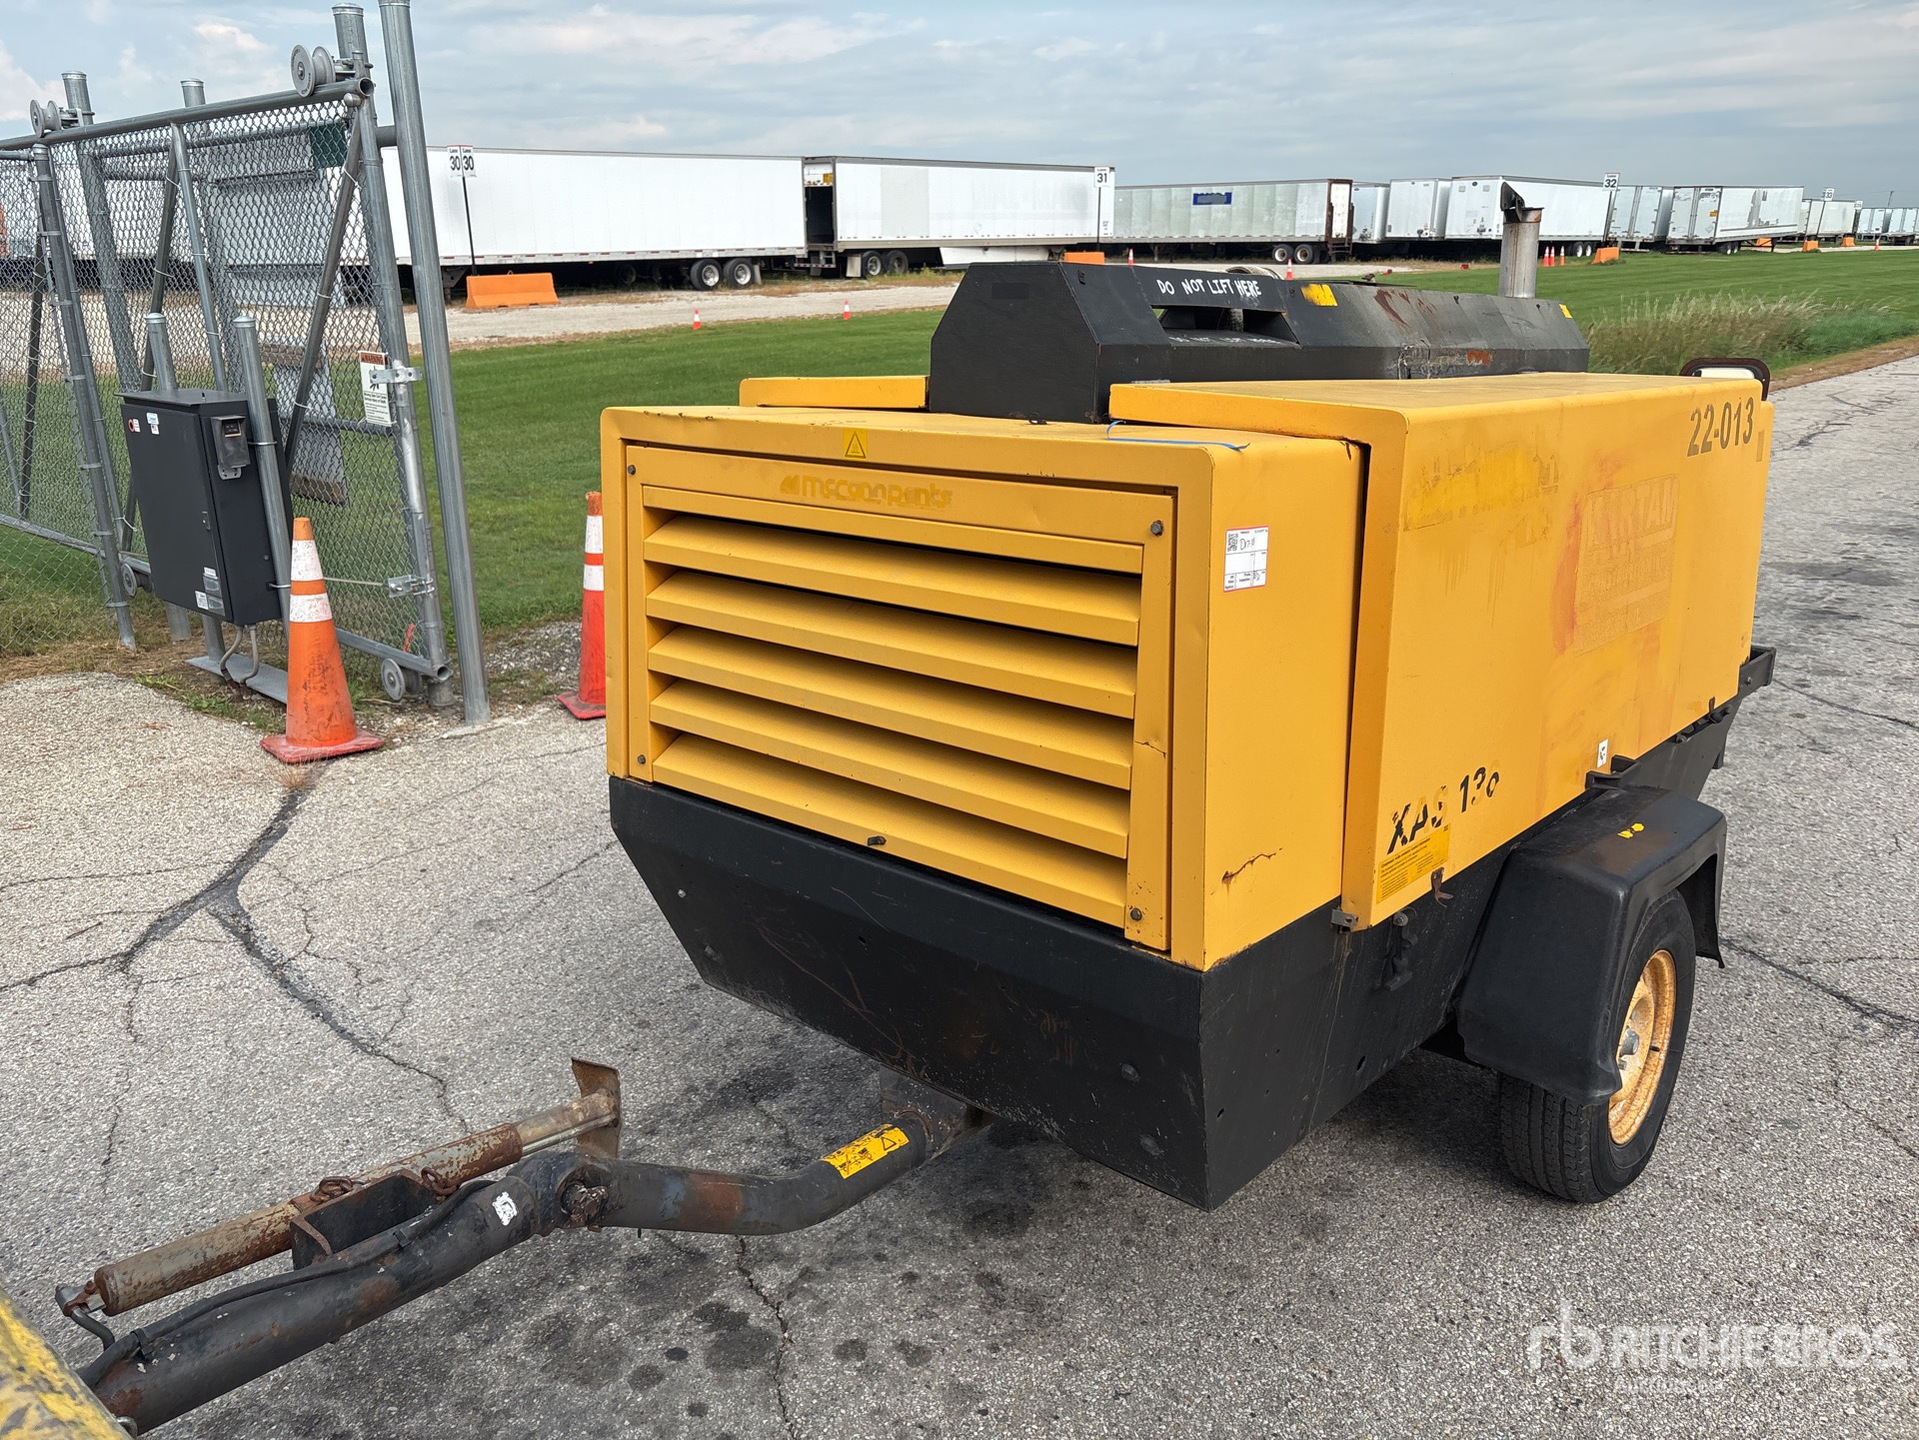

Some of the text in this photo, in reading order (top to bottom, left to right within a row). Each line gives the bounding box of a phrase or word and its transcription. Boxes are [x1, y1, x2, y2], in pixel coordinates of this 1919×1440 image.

[450, 155, 460, 170] 30
[463, 155, 474, 170] 30
[1097, 172, 1108, 183] 31
[1604, 179, 1617, 188] 32
[1156, 279, 1262, 298] DO NOT LIFT HERE
[1687, 397, 1754, 457] 22-013
[1386, 785, 1448, 855] XAS
